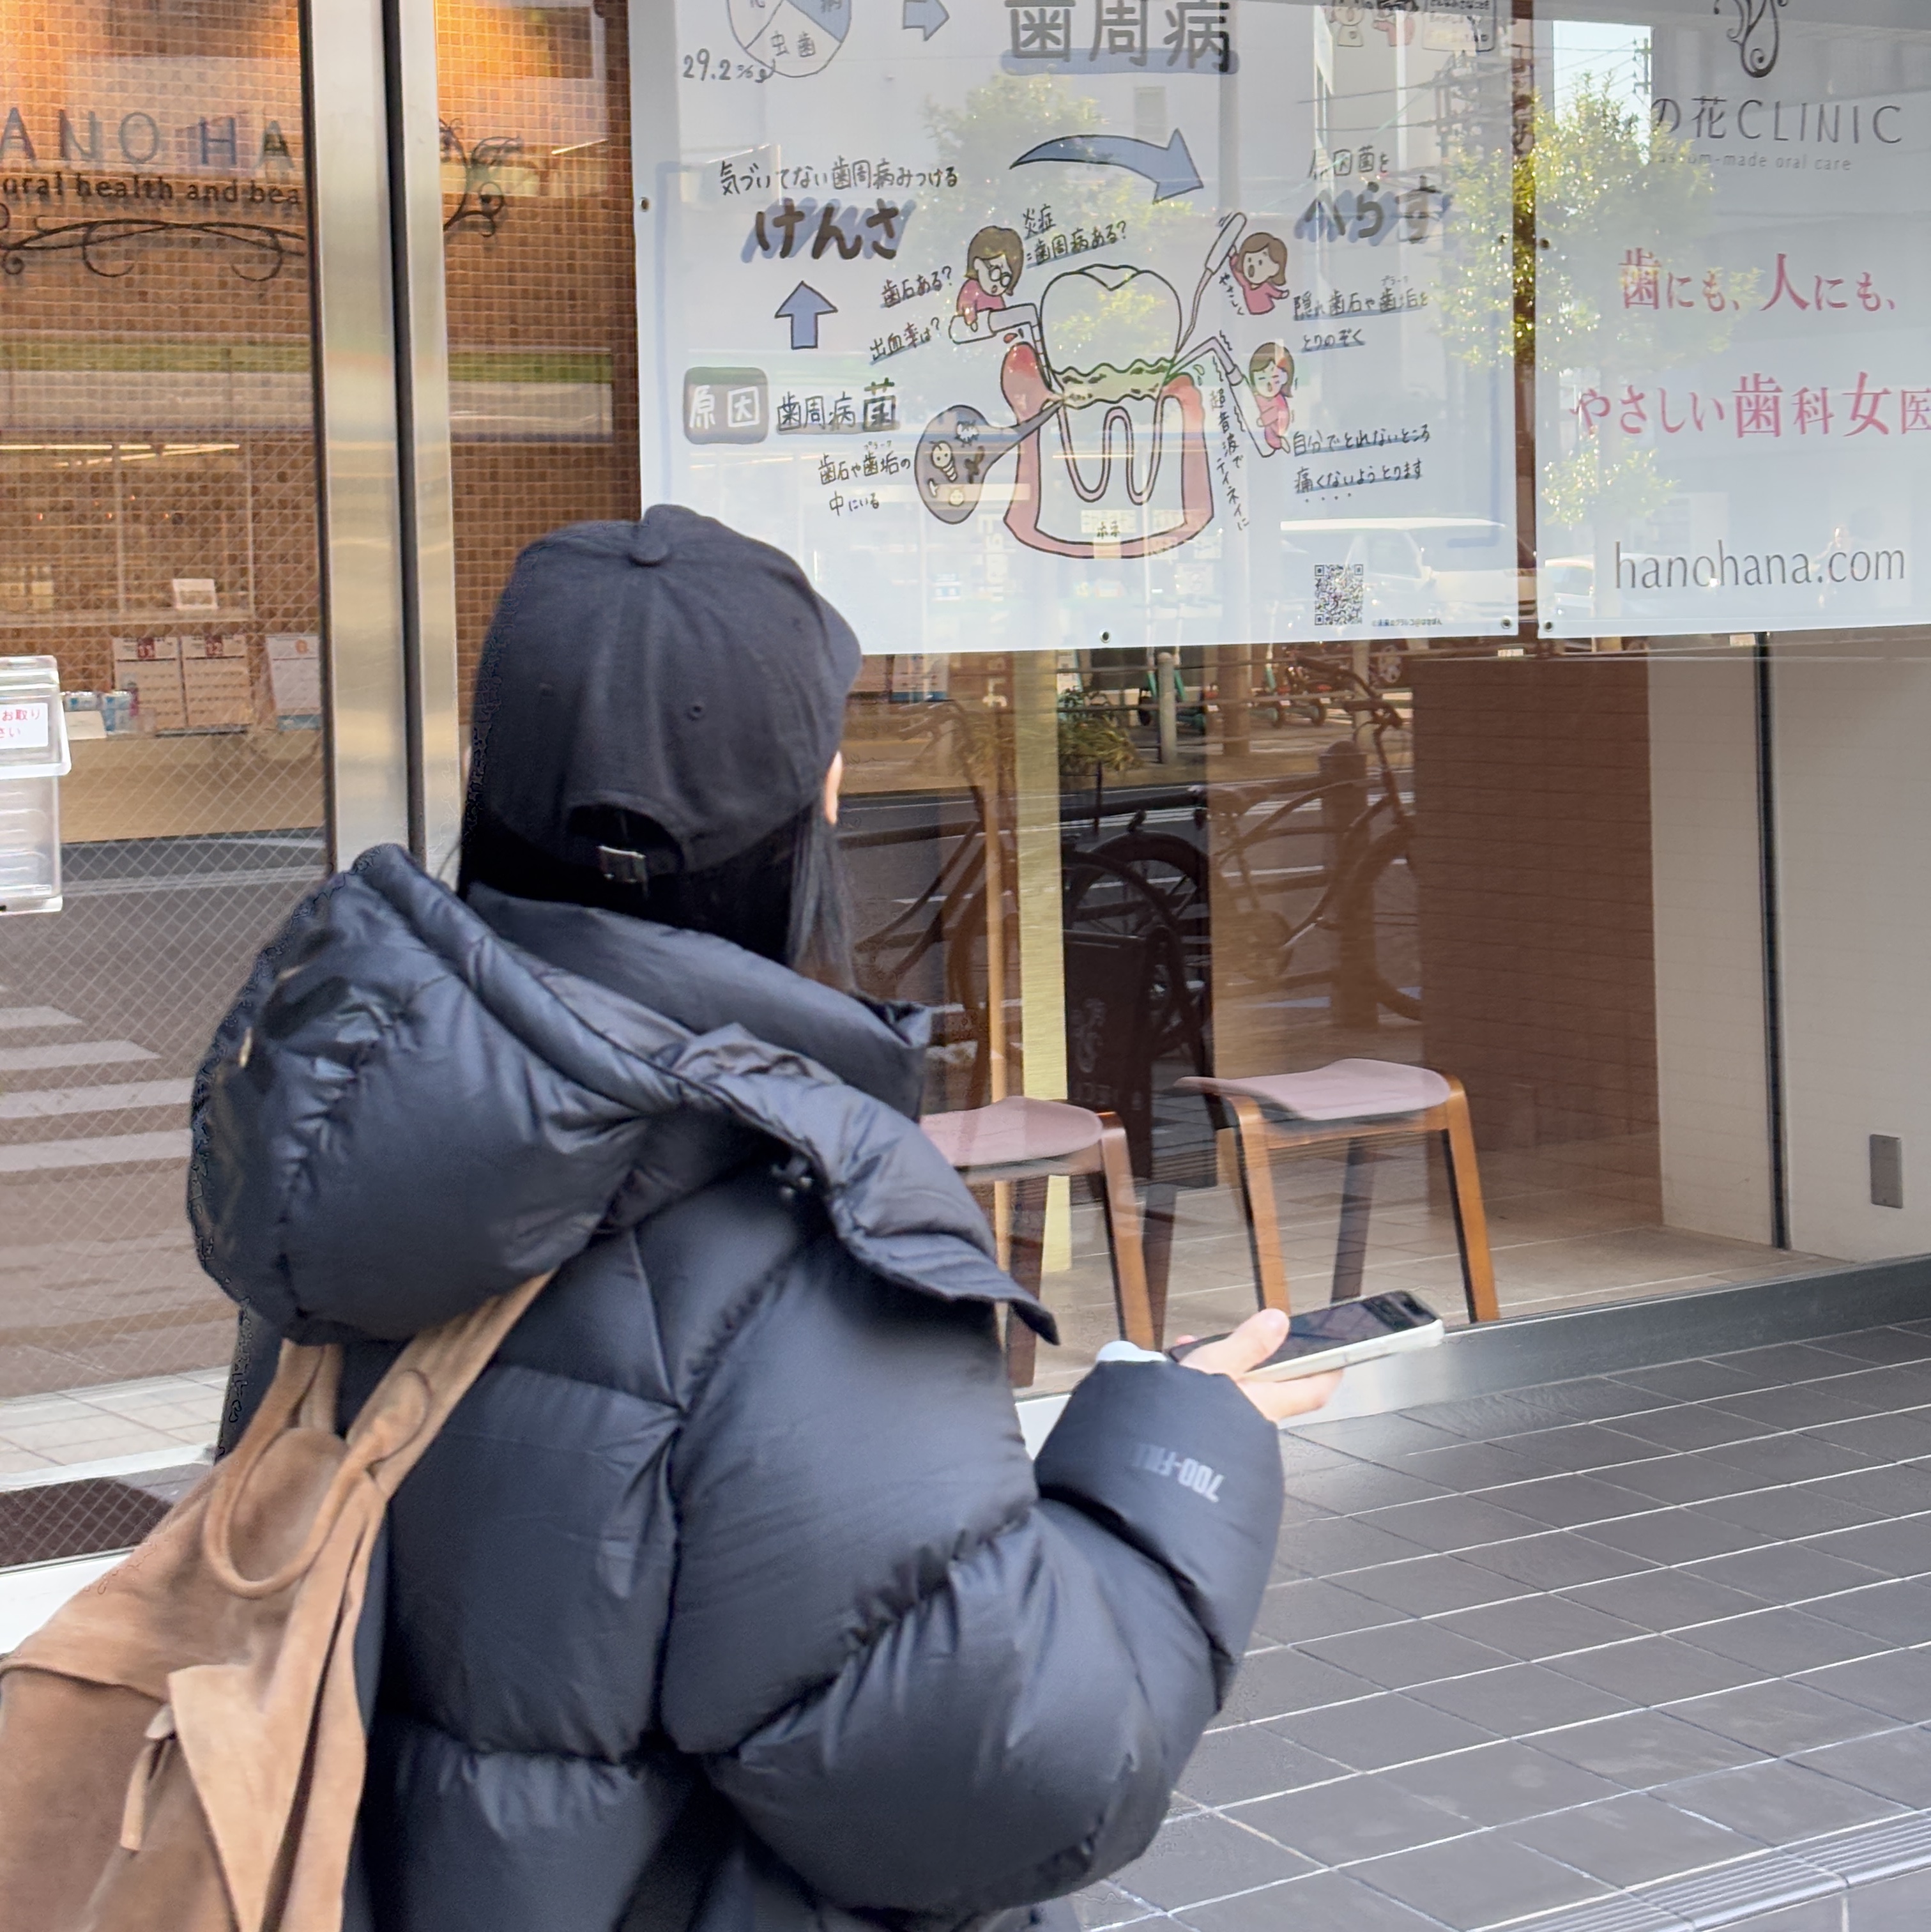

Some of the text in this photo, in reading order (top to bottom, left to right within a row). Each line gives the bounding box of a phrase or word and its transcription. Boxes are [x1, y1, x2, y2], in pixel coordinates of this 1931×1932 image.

[770, 30, 817, 58] 虫歯
[1004, 0, 1230, 73] 歯周病
[1775, 152, 1807, 169] oral
[1814, 157, 1852, 171] care
[75, 171, 174, 201] health
[188, 178, 238, 204] and
[756, 197, 899, 260] けんさ
[1022, 203, 1057, 239] 炎症
[1304, 328, 1366, 351] とりのぞく
[689, 384, 761, 431] 原因
[777, 378, 896, 432] 歯周病菌
[1293, 423, 1431, 457] 自分でとれないところ
[818, 449, 911, 486] 歯石や歯垢の
[828, 489, 880, 517] 中にいる
[1614, 539, 1905, 589] hanohana.com
